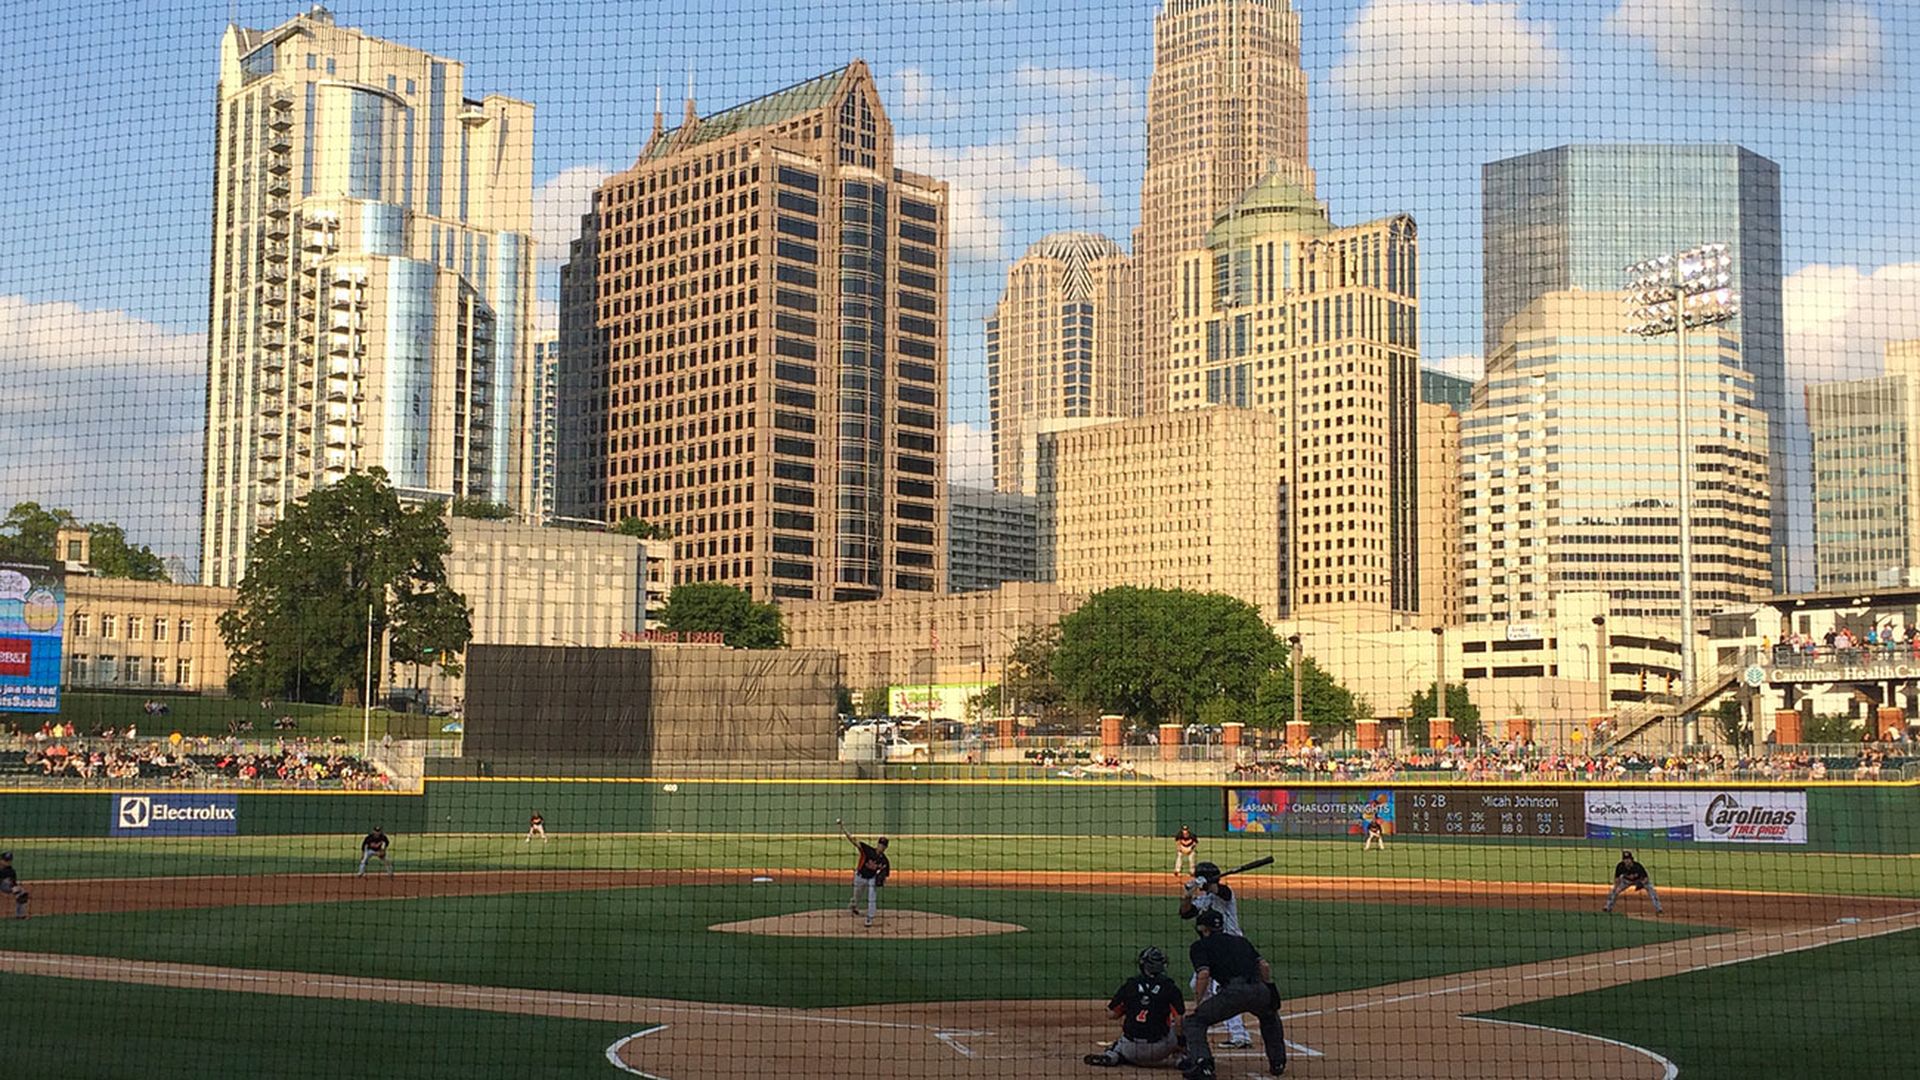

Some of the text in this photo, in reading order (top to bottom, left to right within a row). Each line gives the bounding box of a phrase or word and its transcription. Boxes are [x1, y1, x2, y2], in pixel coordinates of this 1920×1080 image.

[1771, 669, 1840, 682] Carolinas
[663, 783, 678, 792] 400
[1292, 803, 1346, 813] CHARLOTTE
[1349, 803, 1390, 813] KNIGHTS
[1413, 795, 1447, 808] 16 2B
[1482, 795, 1559, 808] Micah Johnson
[152, 803, 236, 820] Electrolux
[1588, 804, 1628, 816] CapTech
[1705, 793, 1797, 830] Carolinas
[1423, 822, 1430, 831] 2
[1516, 823, 1523, 833] 0
[1730, 825, 1786, 840] TIRE PROS
